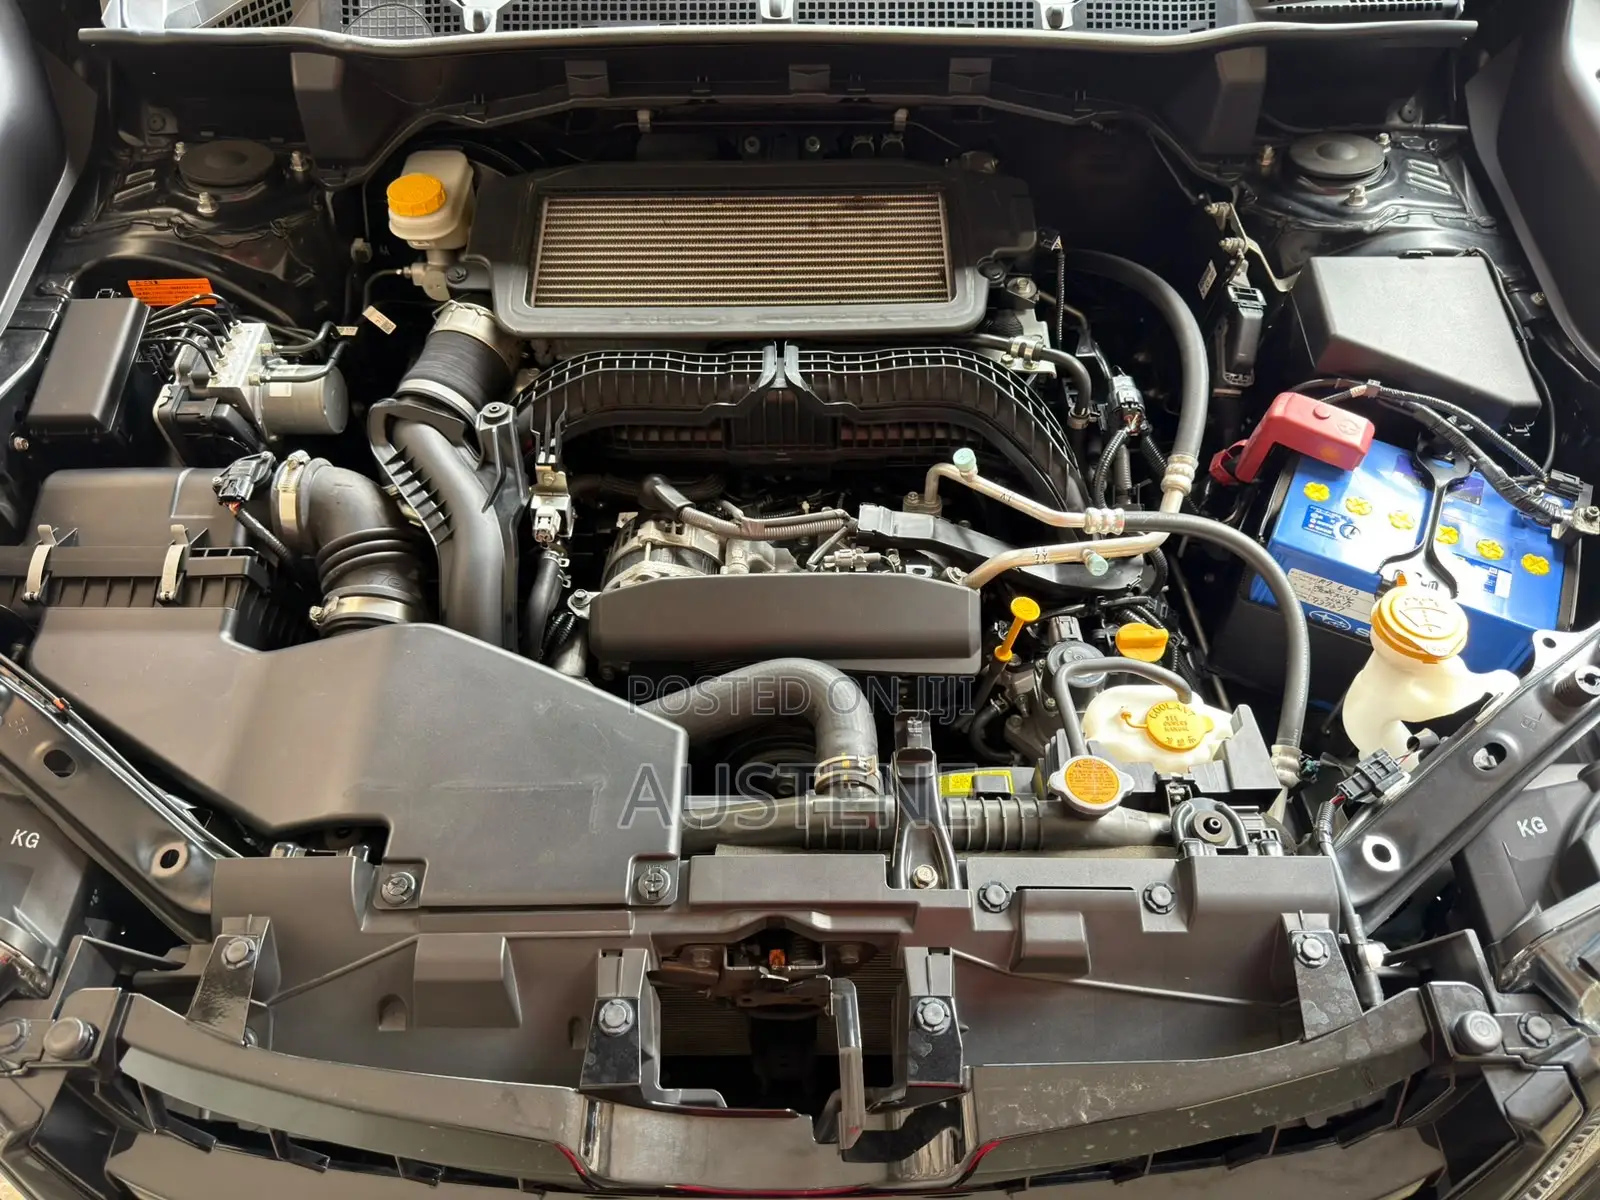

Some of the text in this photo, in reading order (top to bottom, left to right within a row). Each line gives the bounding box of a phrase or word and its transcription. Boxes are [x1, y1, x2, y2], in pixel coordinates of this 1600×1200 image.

[1148, 702, 1196, 718] COOLANT
[1516, 816, 1548, 838] KG
[10, 828, 41, 849] KG
